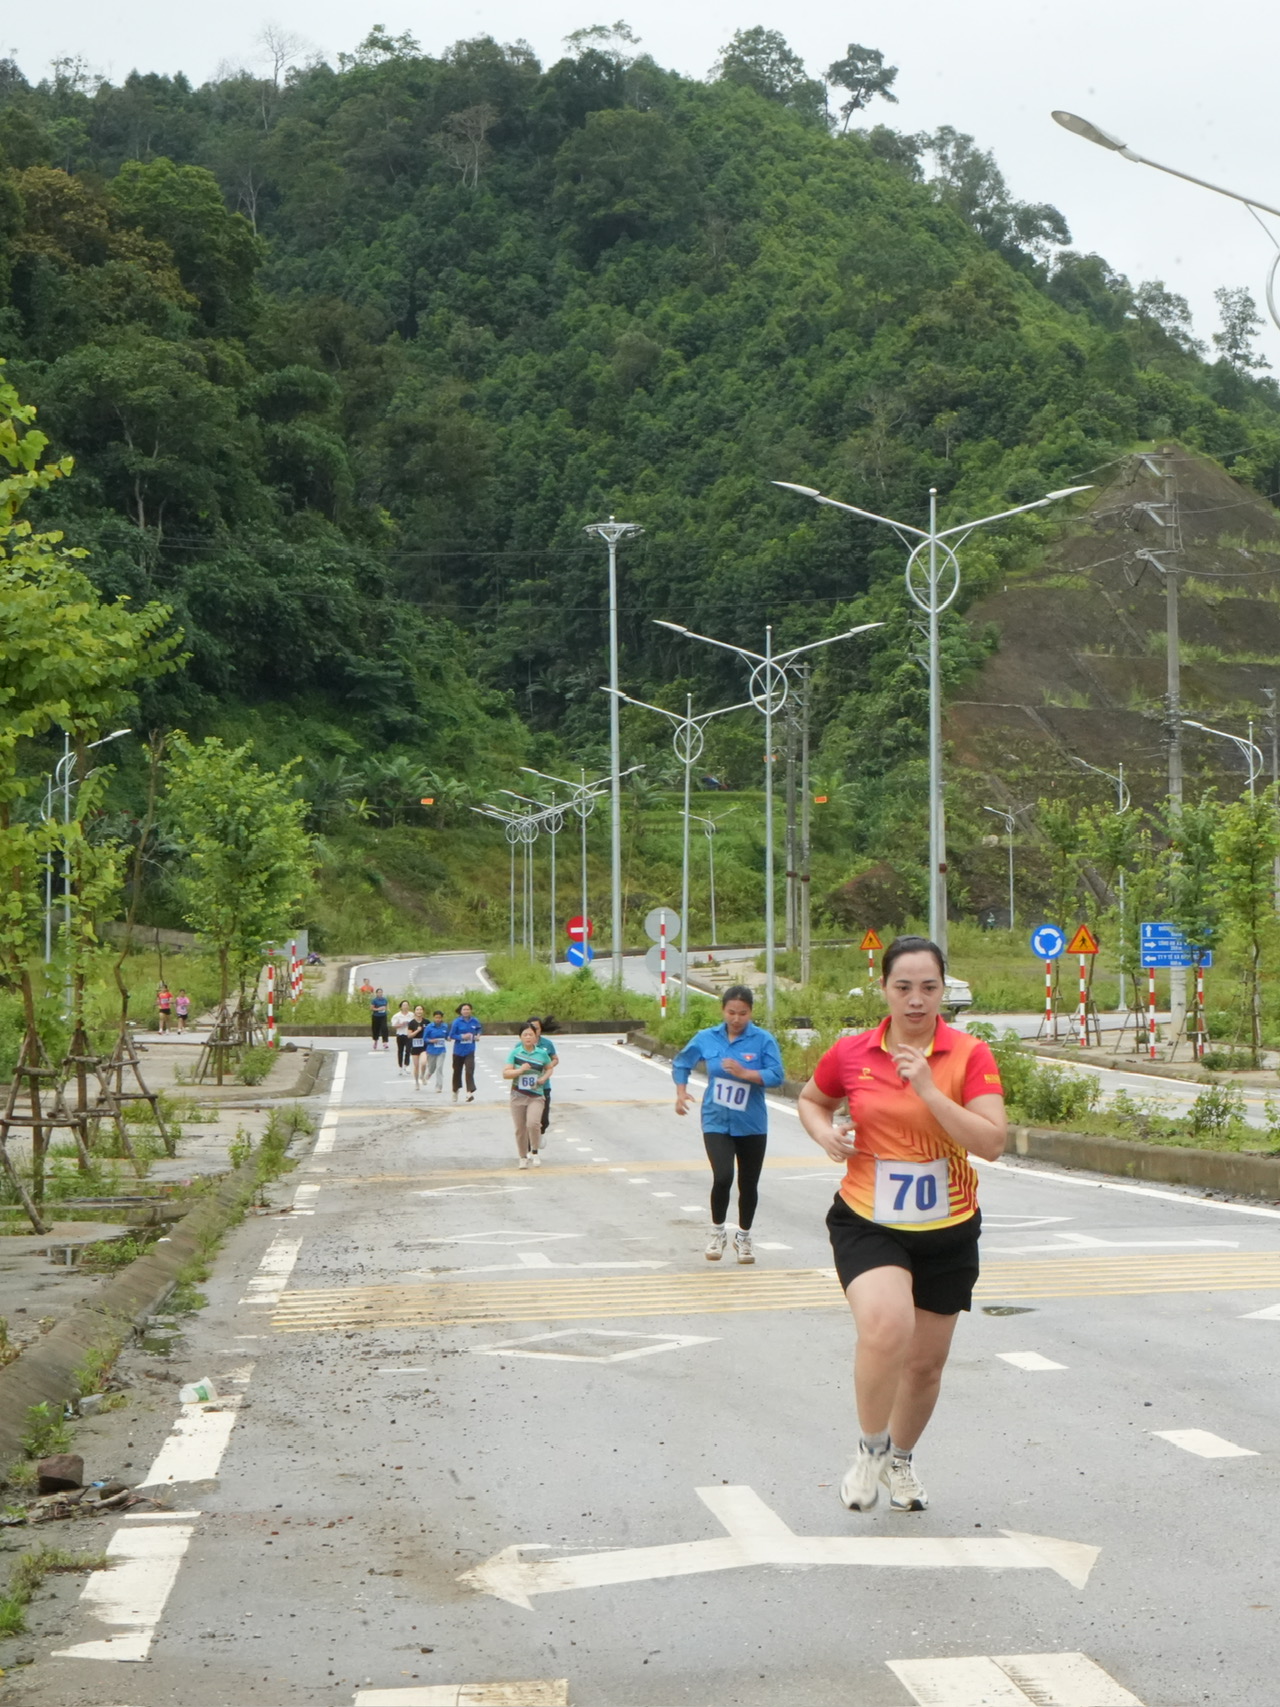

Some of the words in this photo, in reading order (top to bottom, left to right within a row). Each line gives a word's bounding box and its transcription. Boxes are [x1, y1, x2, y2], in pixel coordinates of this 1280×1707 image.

[521, 1076, 535, 1087] 68
[716, 1083, 746, 1105] 110
[889, 1173, 937, 1211] 70
